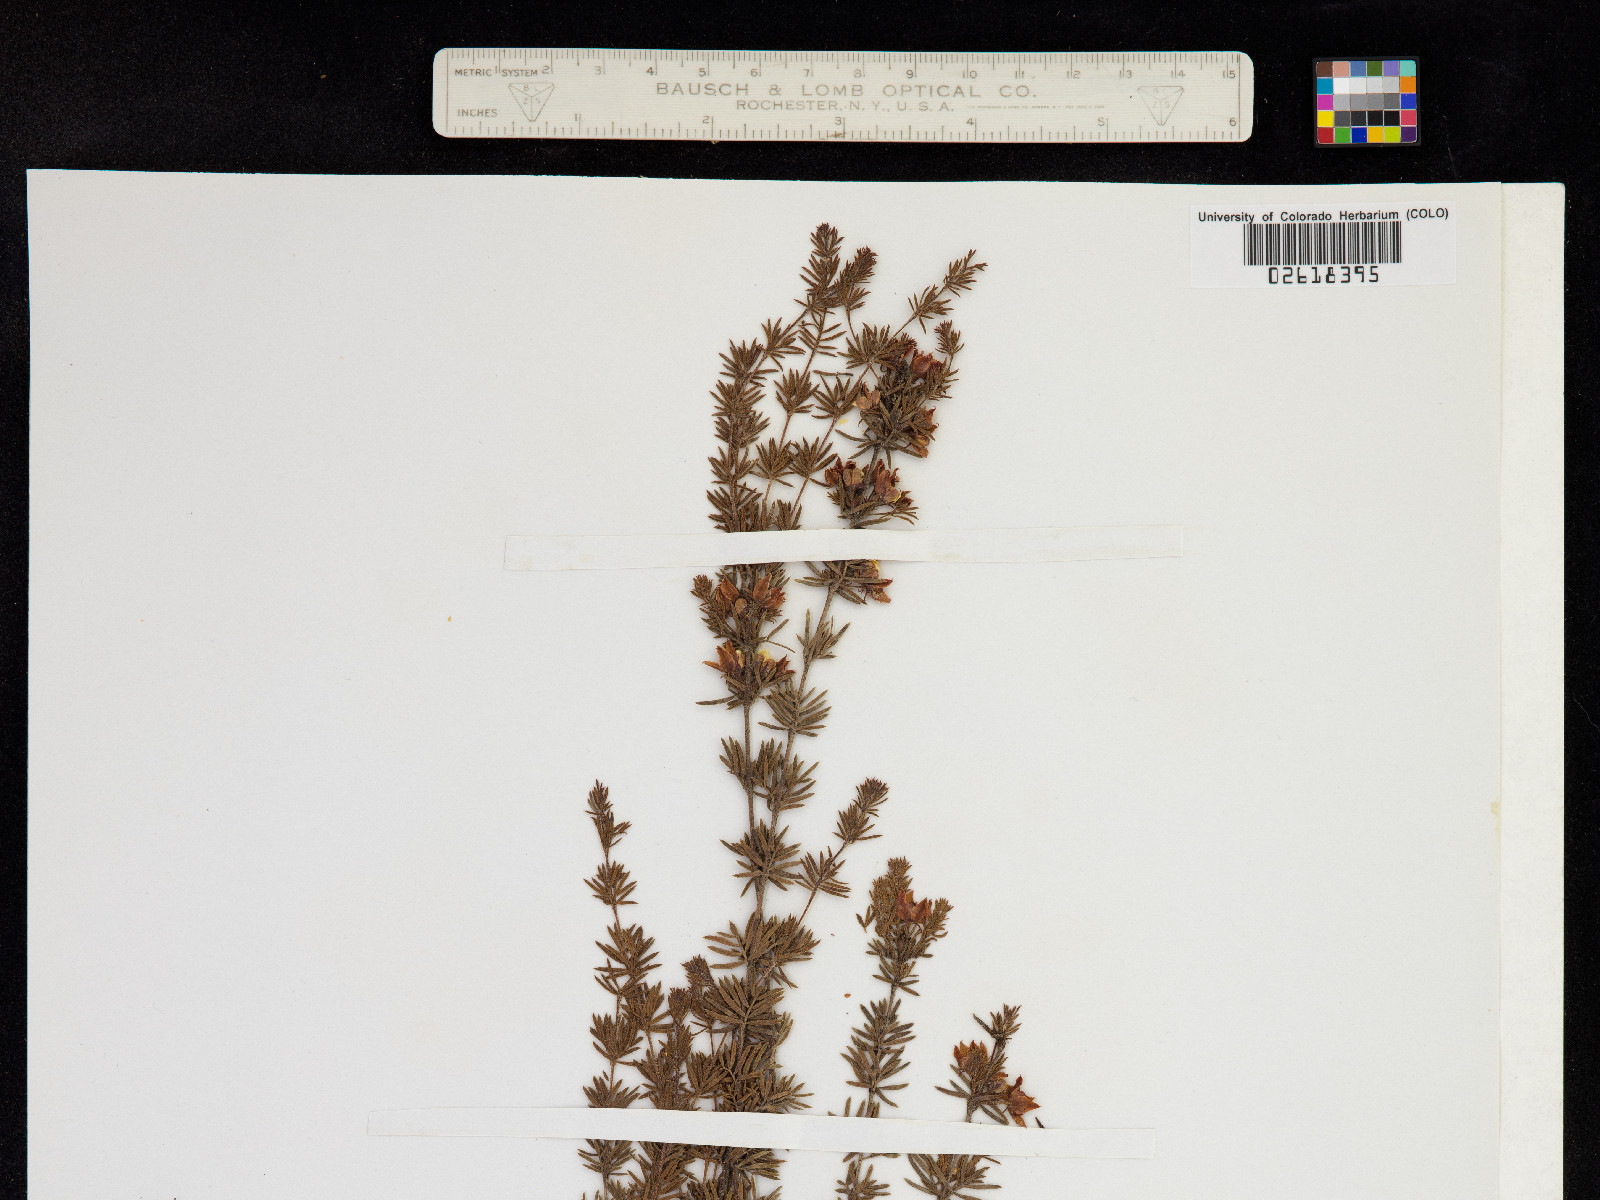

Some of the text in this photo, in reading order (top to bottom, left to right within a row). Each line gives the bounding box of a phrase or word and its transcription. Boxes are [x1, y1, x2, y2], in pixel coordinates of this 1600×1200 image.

[454, 68, 538, 77] METRIC SYSTEM
[541, 65, 550, 74] 2
[594, 65, 602, 76] 3
[645, 66, 654, 76] 4
[697, 67, 707, 77] 5
[750, 68, 759, 78] 6
[803, 68, 810, 78] 7
[853, 69, 862, 79] 8
[906, 70, 914, 79] 9
[962, 70, 978, 79] 10
[1066, 70, 1081, 80] 12
[1118, 70, 1133, 80] 13
[1170, 70, 1186, 79] 14
[1222, 70, 1236, 80] 15
[656, 82, 1037, 98] BAUSCH & LOMB OPTICAL CO.
[457, 108, 498, 118] INCHES
[939, 101, 954, 112] A.
[702, 115, 710, 124] 2
[834, 117, 842, 126] 3
[966, 117, 975, 126] 4
[1228, 117, 1237, 127] 6
[1198, 208, 1449, 224] University of Colorado Herbarium (COLO)
[1268, 265, 1379, 285] 02618395
